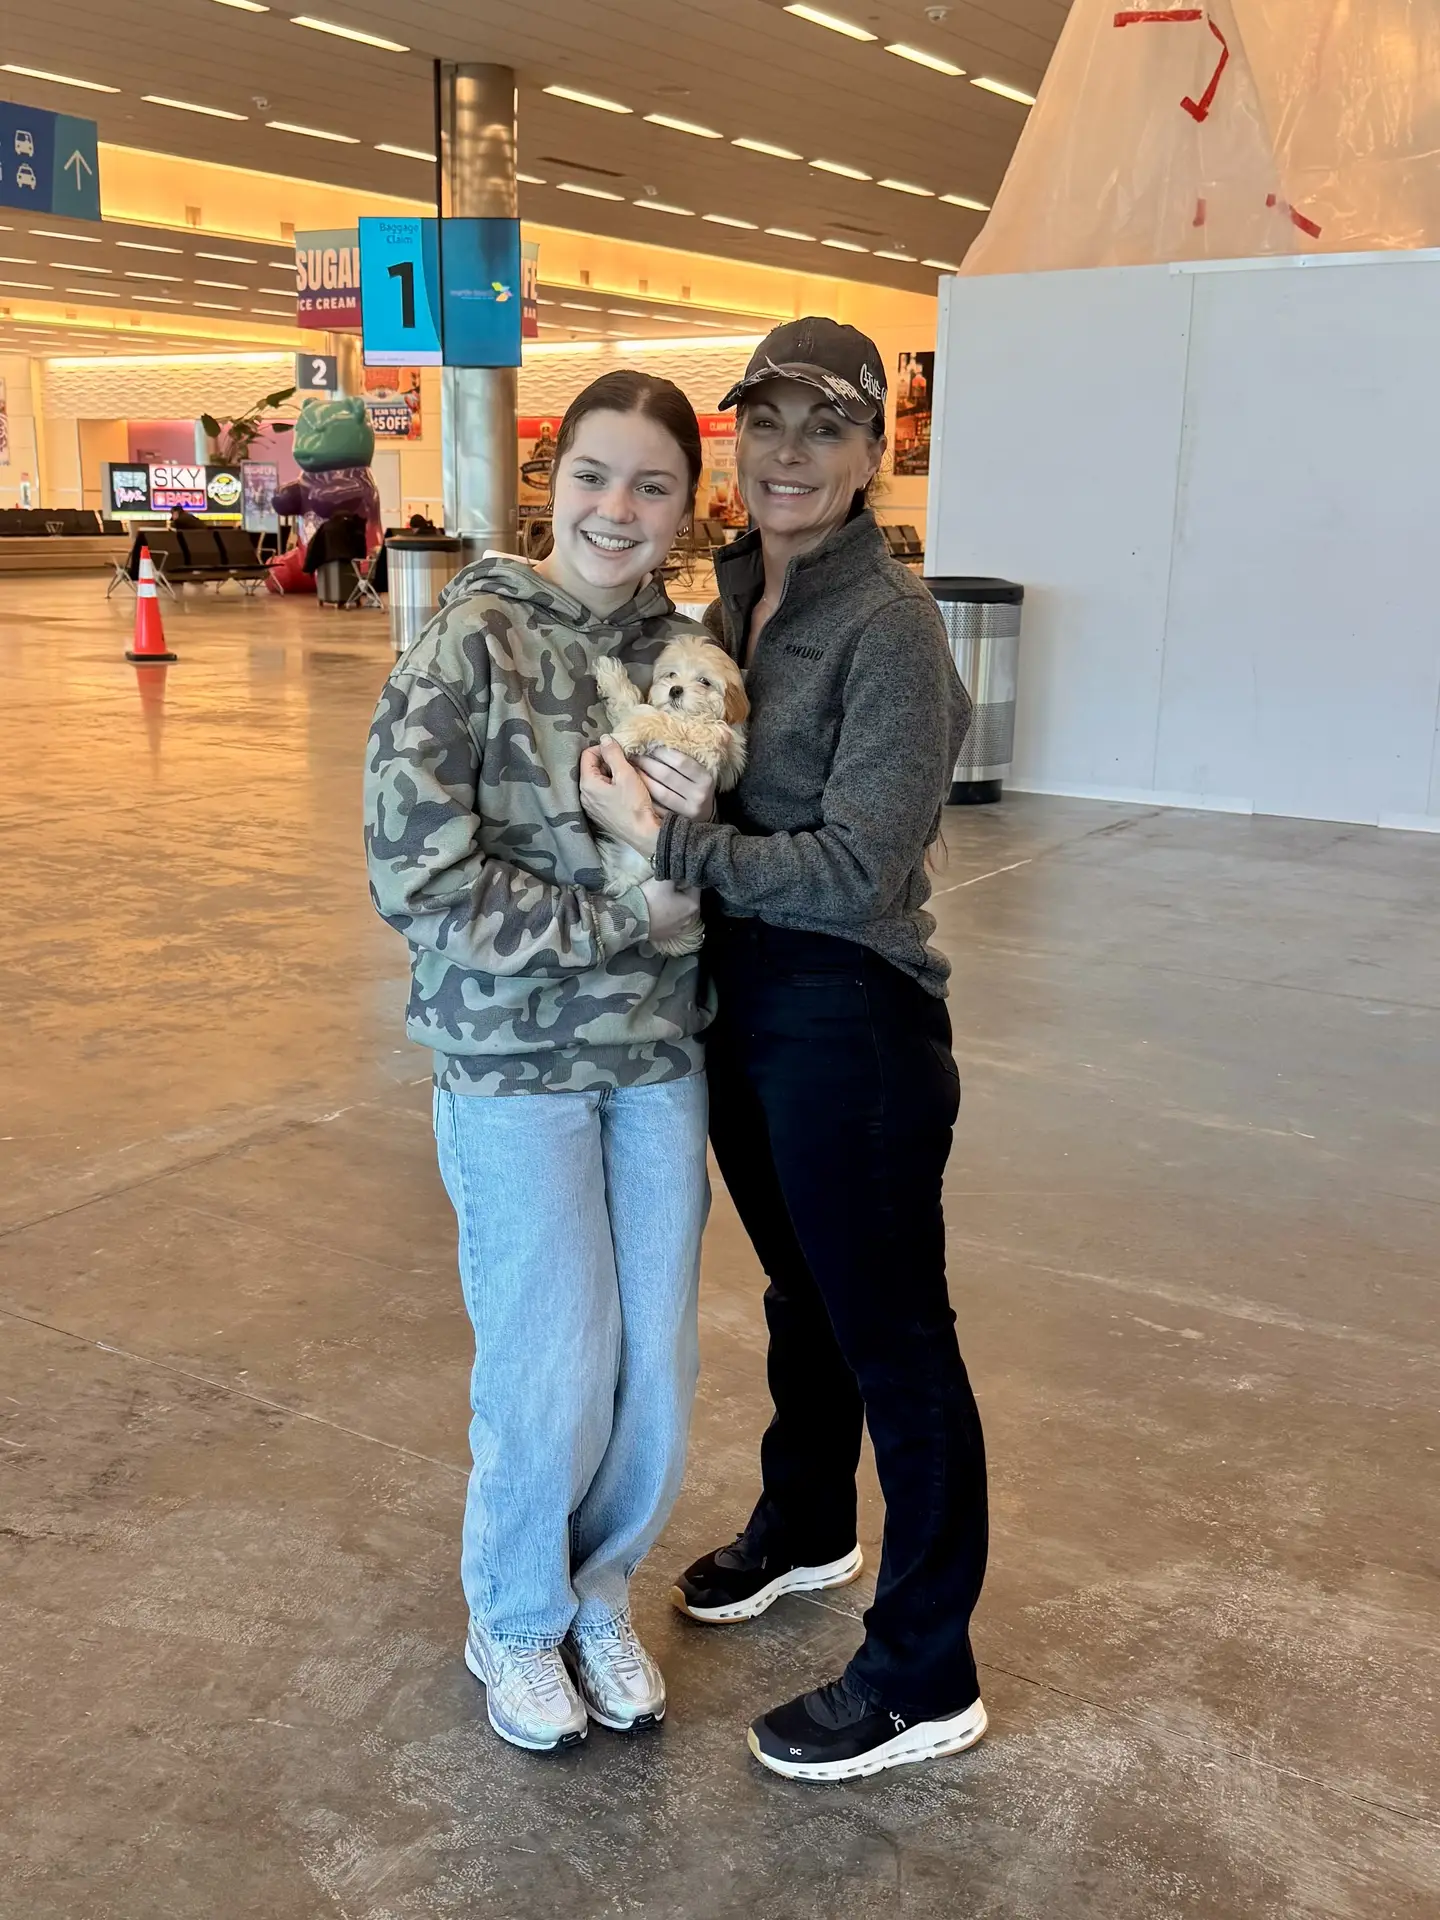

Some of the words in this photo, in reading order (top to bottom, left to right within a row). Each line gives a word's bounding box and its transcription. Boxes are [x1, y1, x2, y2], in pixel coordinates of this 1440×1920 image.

[379, 223, 419, 234] Baggage
[386, 235, 413, 244] Claim
[387, 262, 415, 328] 1
[316, 296, 356, 310] CREAM
[311, 358, 327, 386] 2
[154, 467, 201, 488] SKY
[165, 491, 192, 506] BAR
